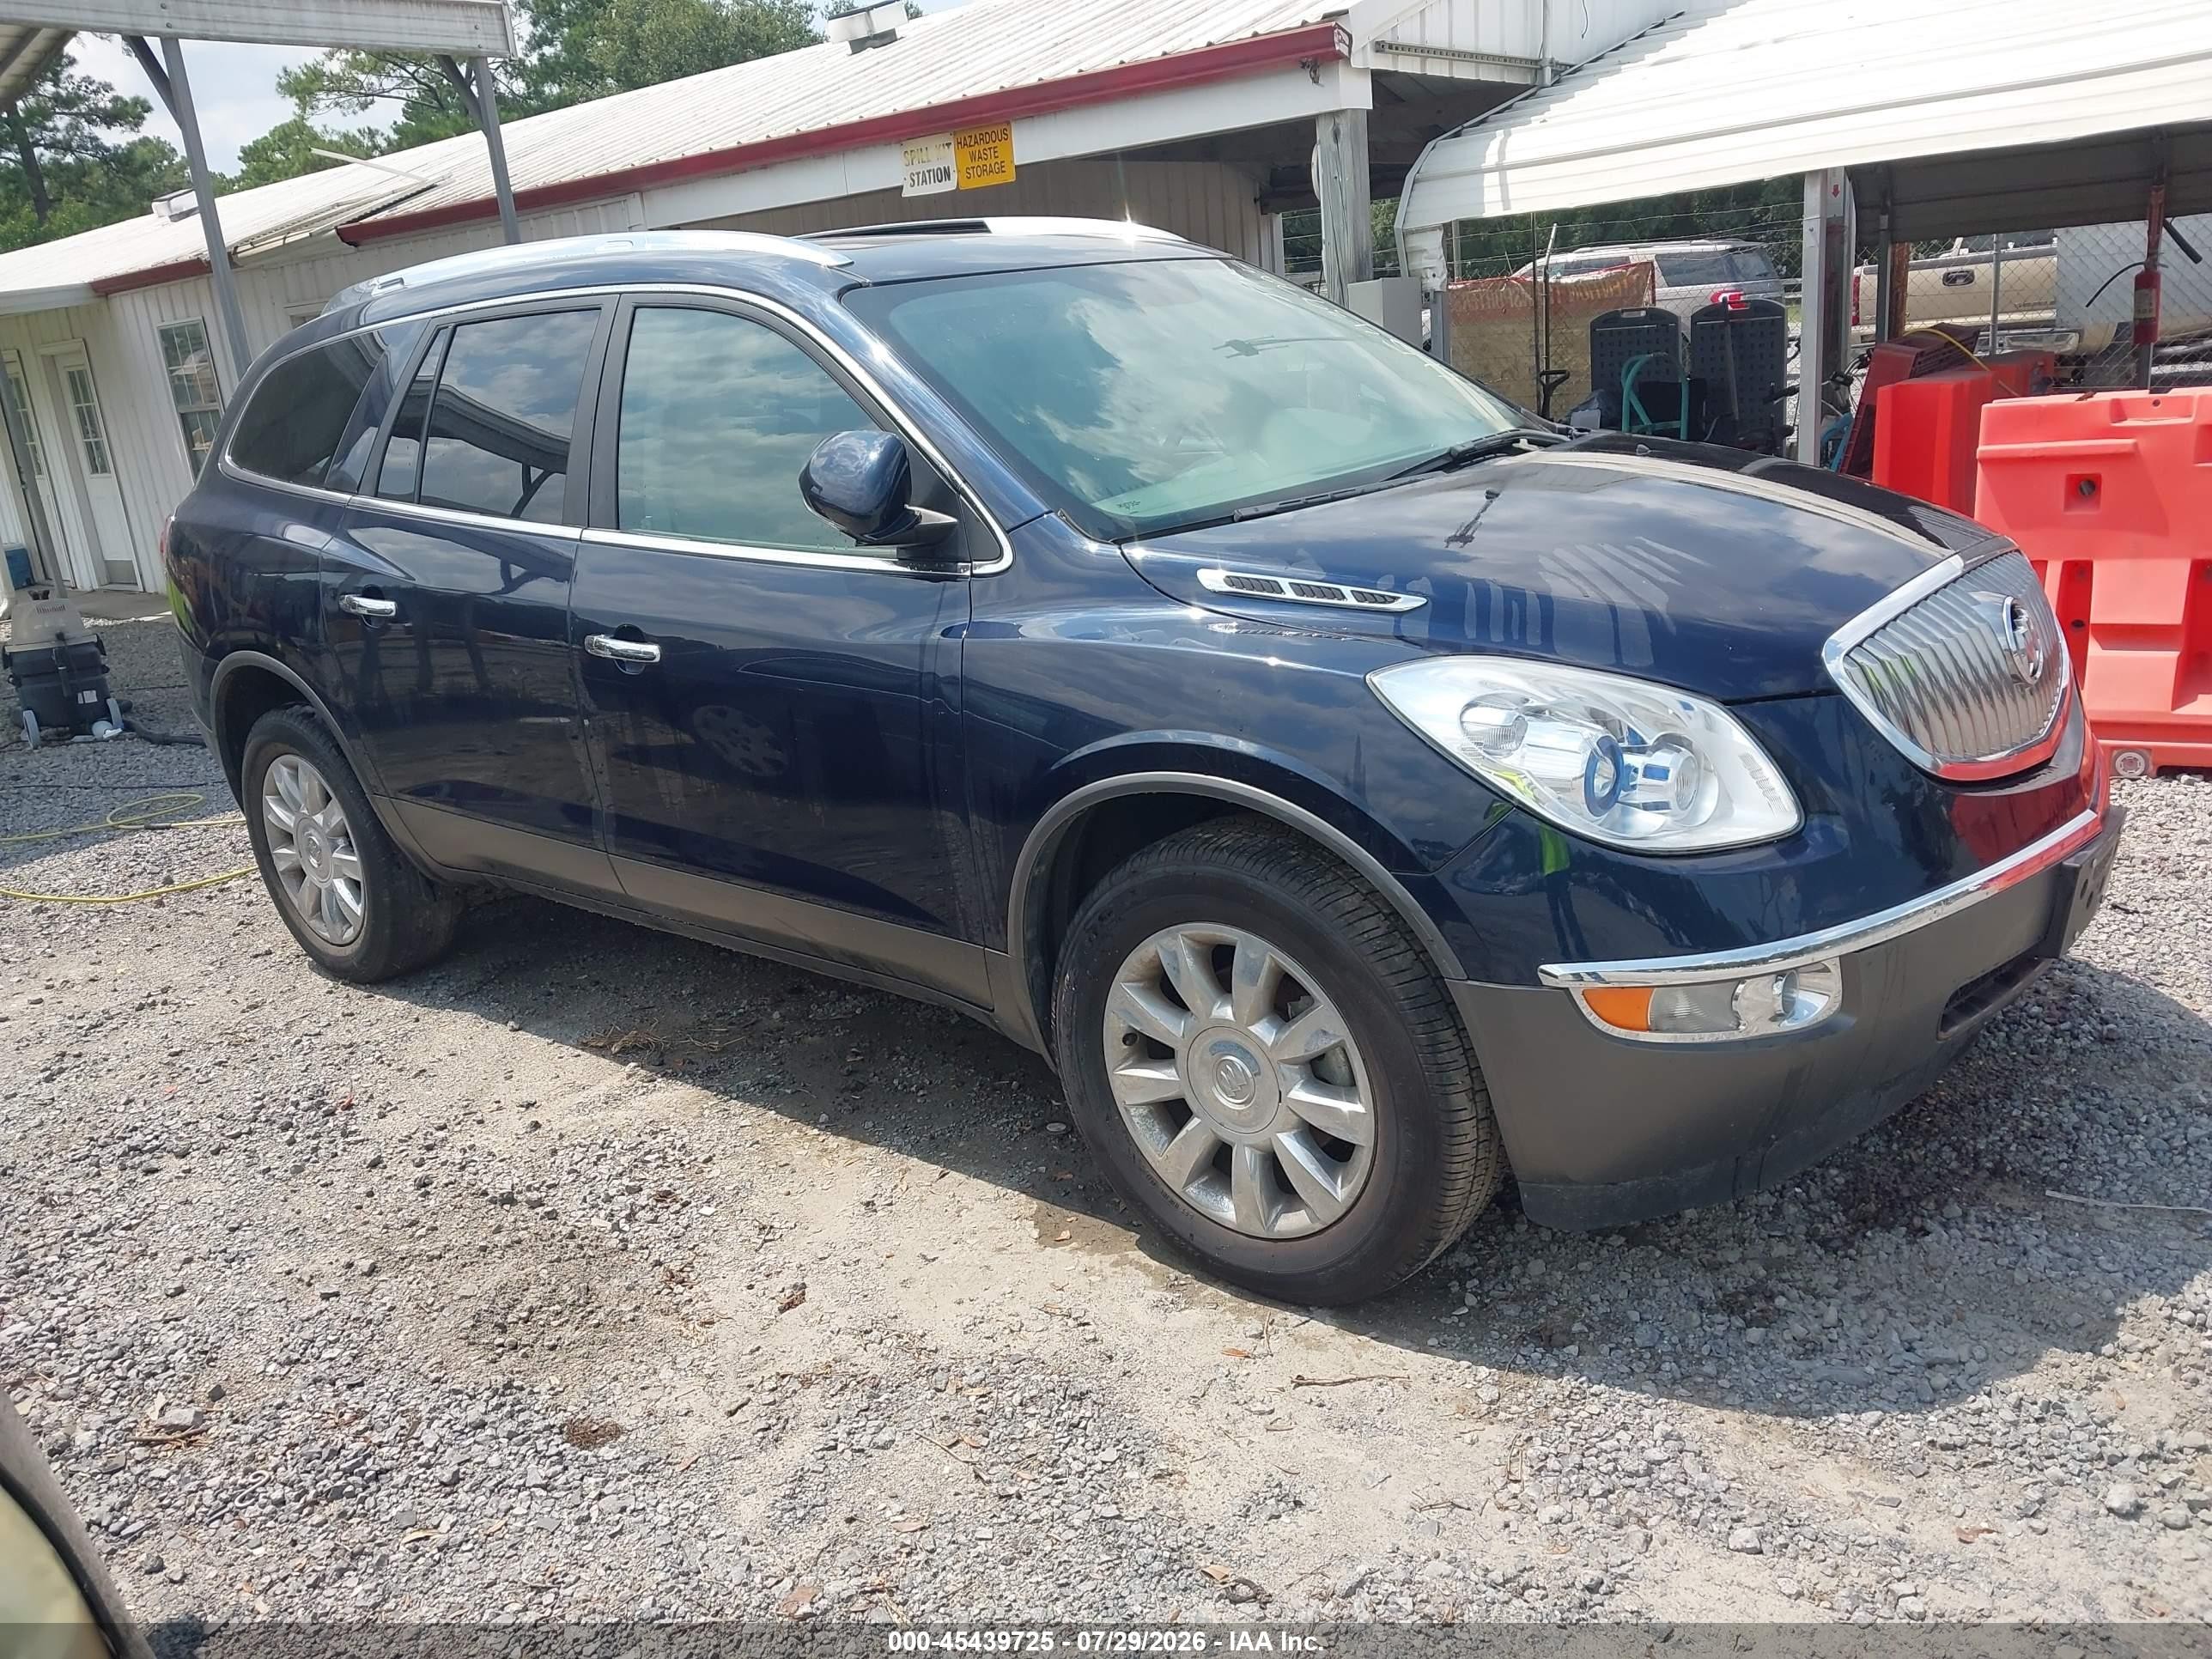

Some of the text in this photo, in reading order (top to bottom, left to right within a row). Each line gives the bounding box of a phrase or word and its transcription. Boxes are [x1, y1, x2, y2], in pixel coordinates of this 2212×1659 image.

[957, 128, 1009, 149] HAZARDOUS
[903, 146, 932, 167] SPILL
[969, 146, 999, 163] WASTE
[909, 166, 951, 188] STATION
[965, 161, 1006, 179] STORAGE
